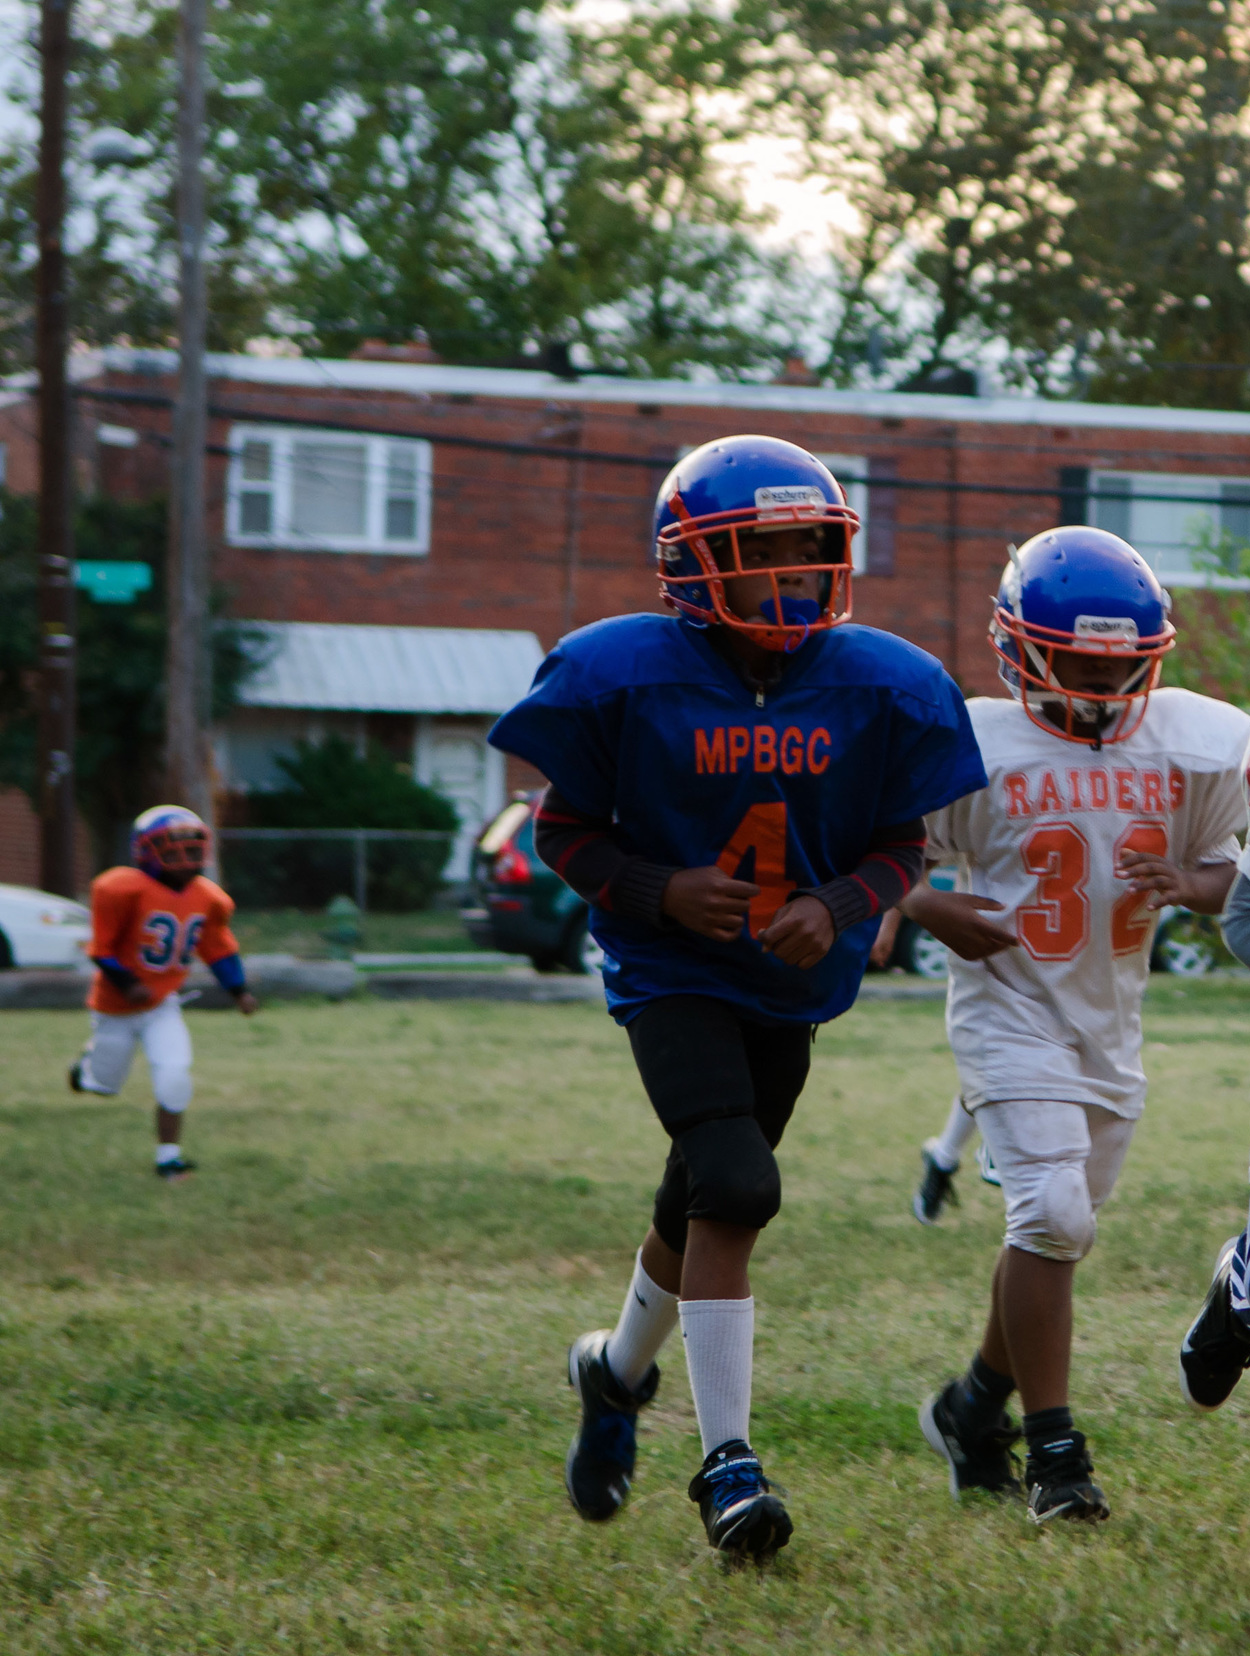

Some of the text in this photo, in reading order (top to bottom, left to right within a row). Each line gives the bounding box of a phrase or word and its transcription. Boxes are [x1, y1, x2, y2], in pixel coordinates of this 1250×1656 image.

[694, 725, 832, 775] MPBGC
[1003, 766, 1187, 820] RAIDERS
[714, 801, 798, 941] 4
[1016, 820, 1171, 961] 32
